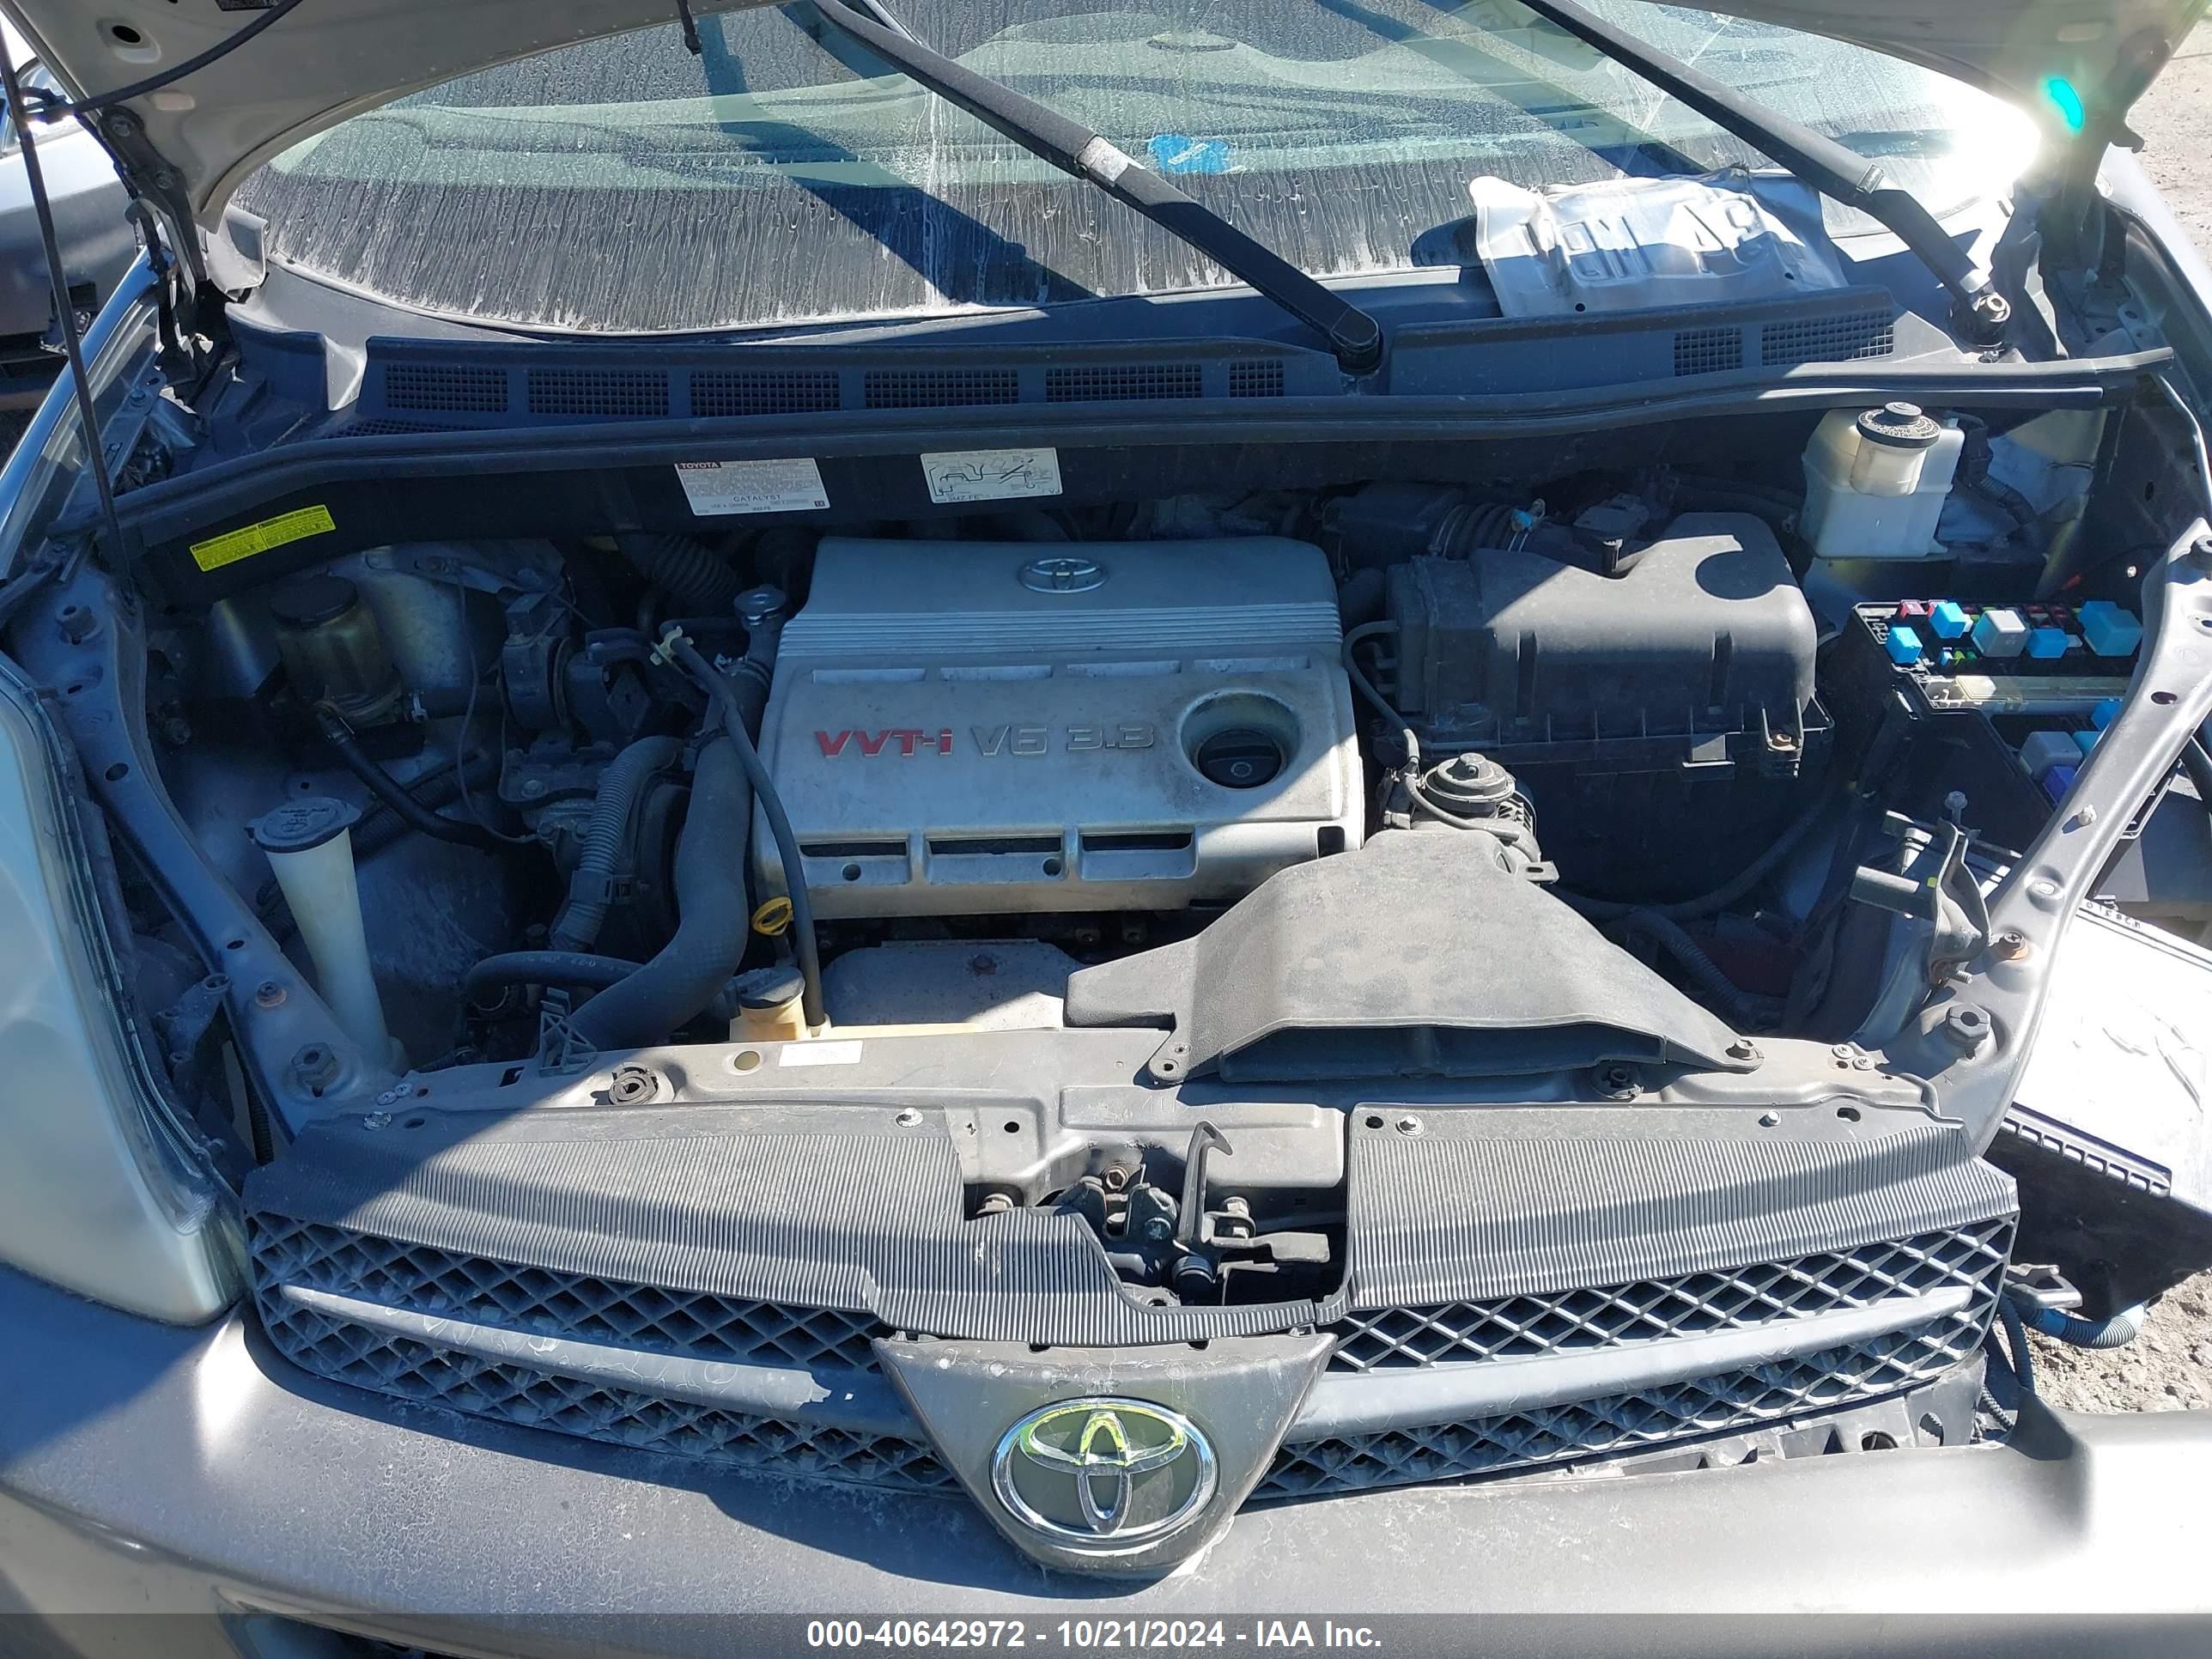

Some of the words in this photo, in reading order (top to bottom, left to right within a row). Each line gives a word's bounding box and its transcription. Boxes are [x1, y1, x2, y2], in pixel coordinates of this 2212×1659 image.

[732, 494, 781, 502] CATALYST
[814, 728, 953, 758] VVT-i
[970, 725, 1048, 757] V6
[1066, 724, 1154, 750] 3.3
